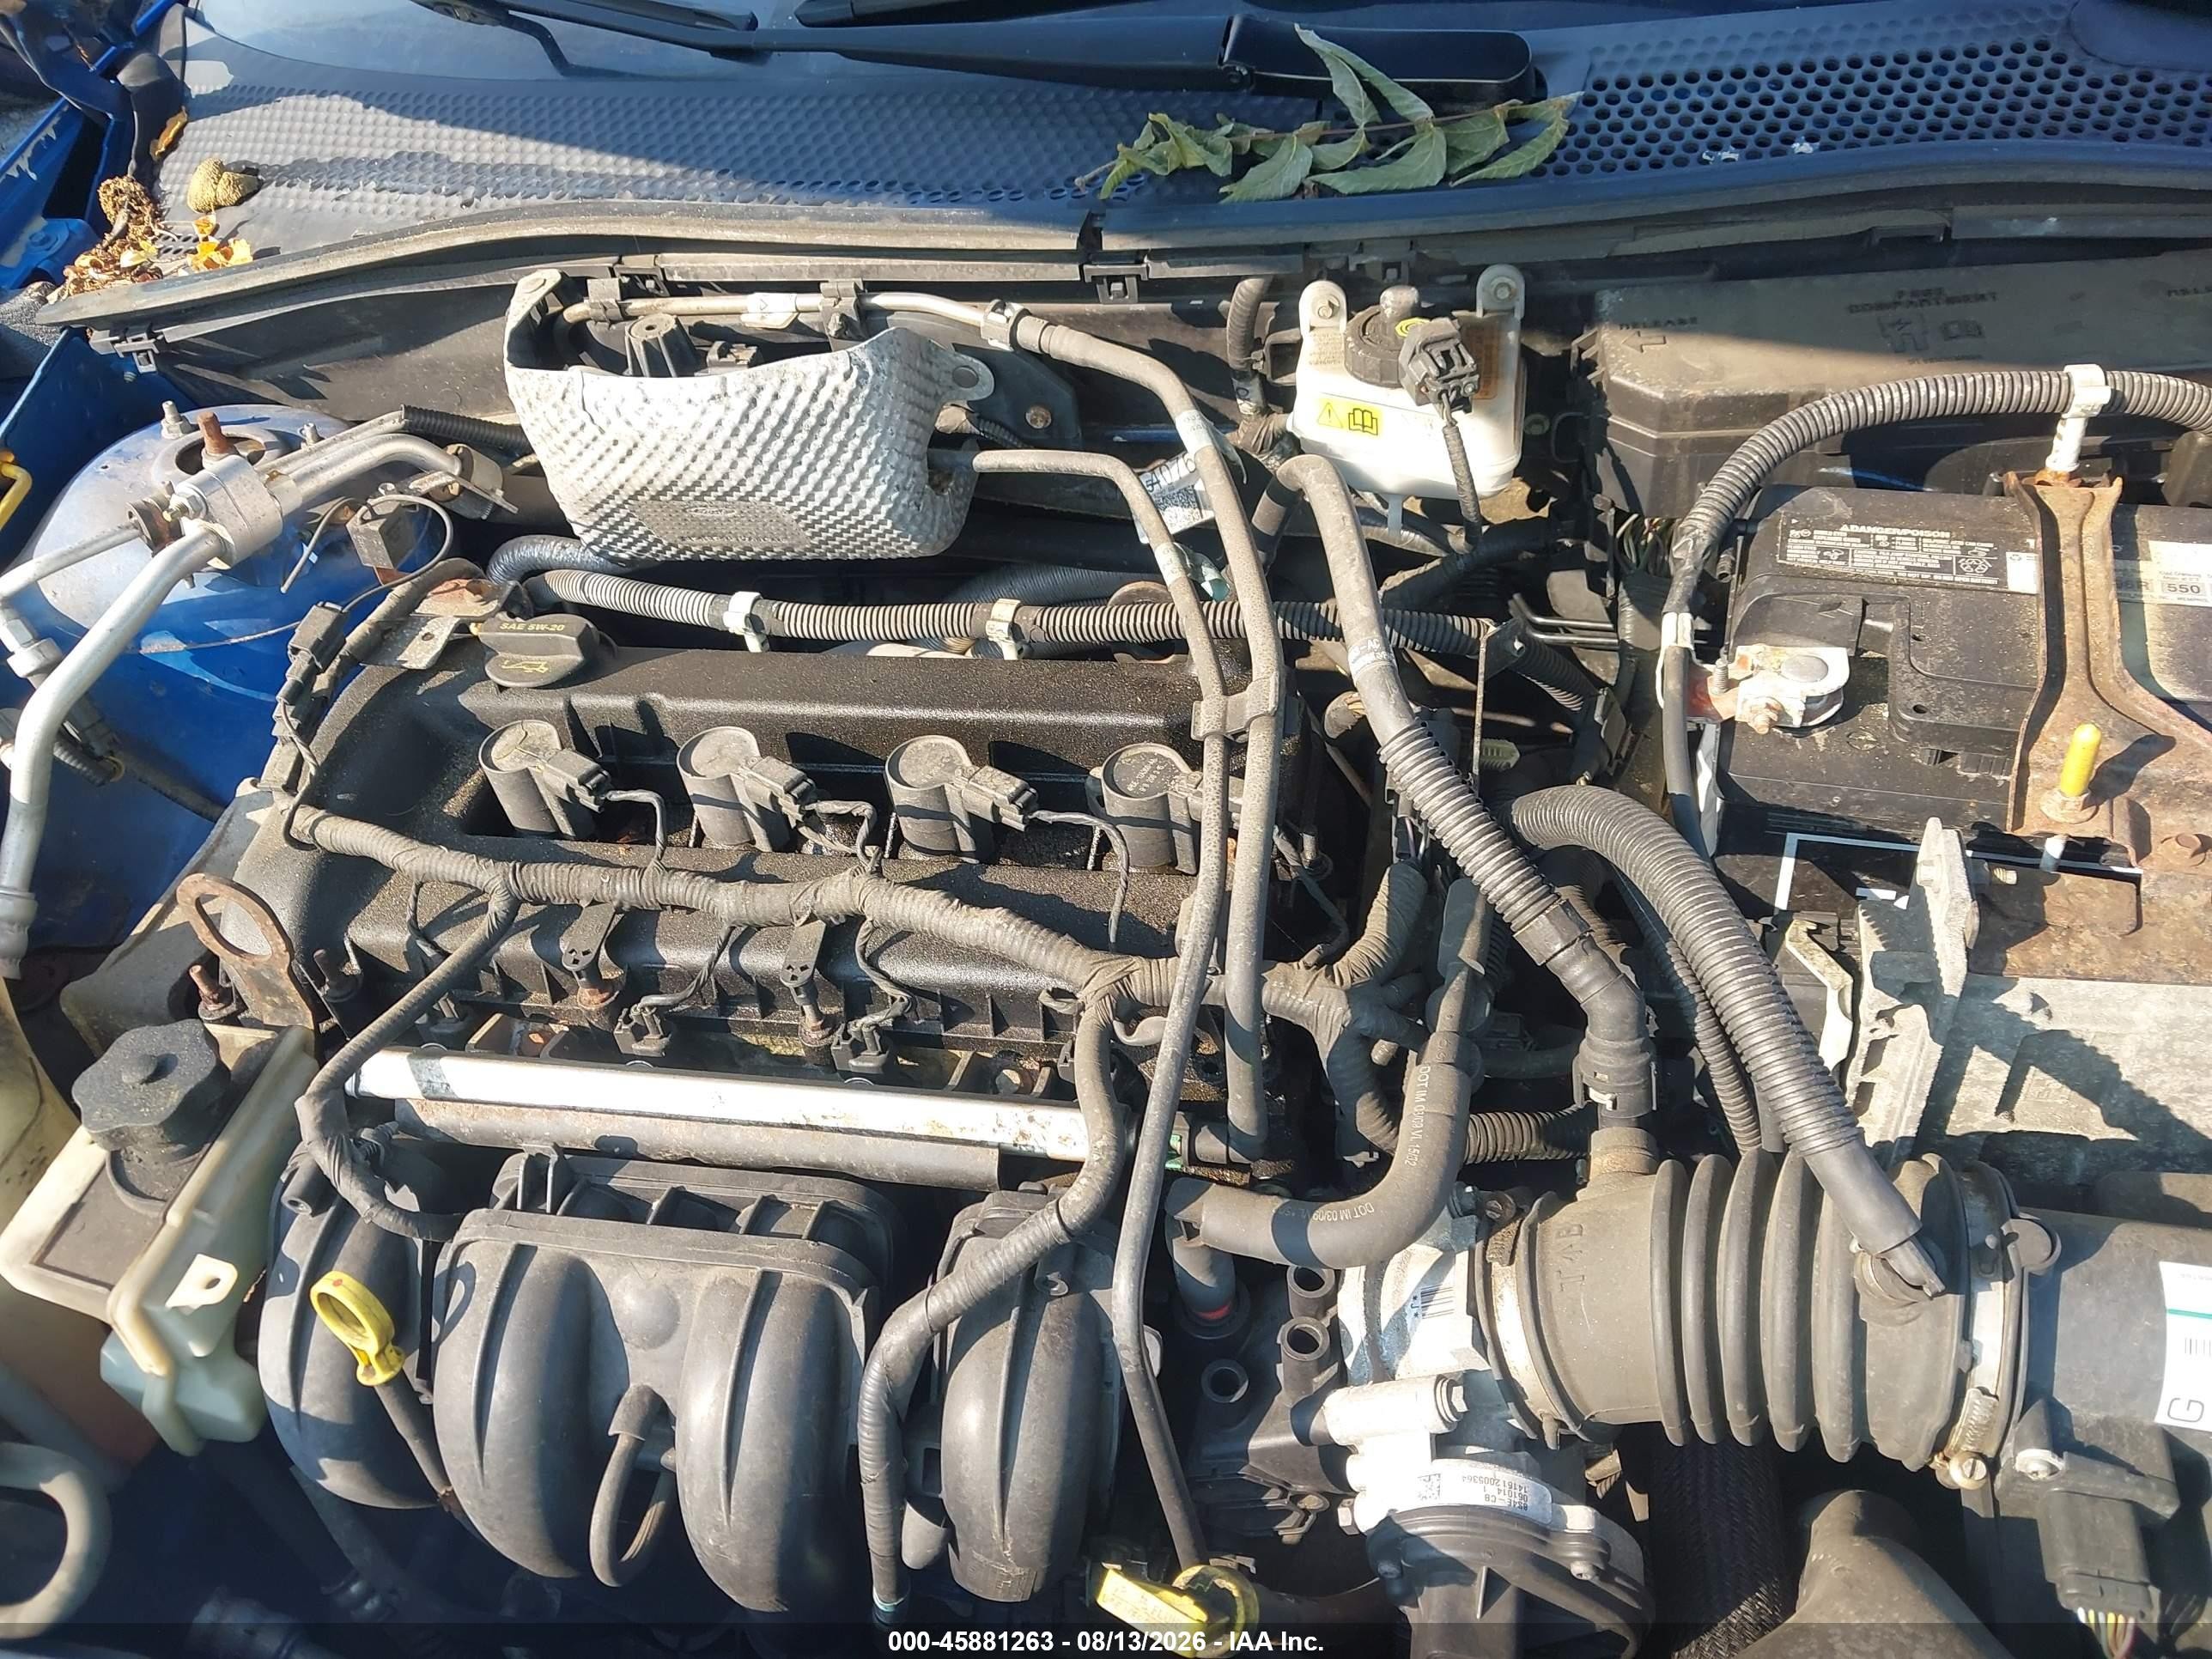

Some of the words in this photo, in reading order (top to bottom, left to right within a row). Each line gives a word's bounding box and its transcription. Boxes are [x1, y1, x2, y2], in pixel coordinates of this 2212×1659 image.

[1850, 524, 1951, 538] DANGER/POISON
[2166, 583, 2201, 594] 550
[1416, 1065, 1431, 1088] DOT
[1414, 1090, 1427, 1103] IM
[1339, 1208, 1352, 1221] IM
[1352, 1201, 1375, 1218] DOT
[2166, 1397, 2205, 1423] G
